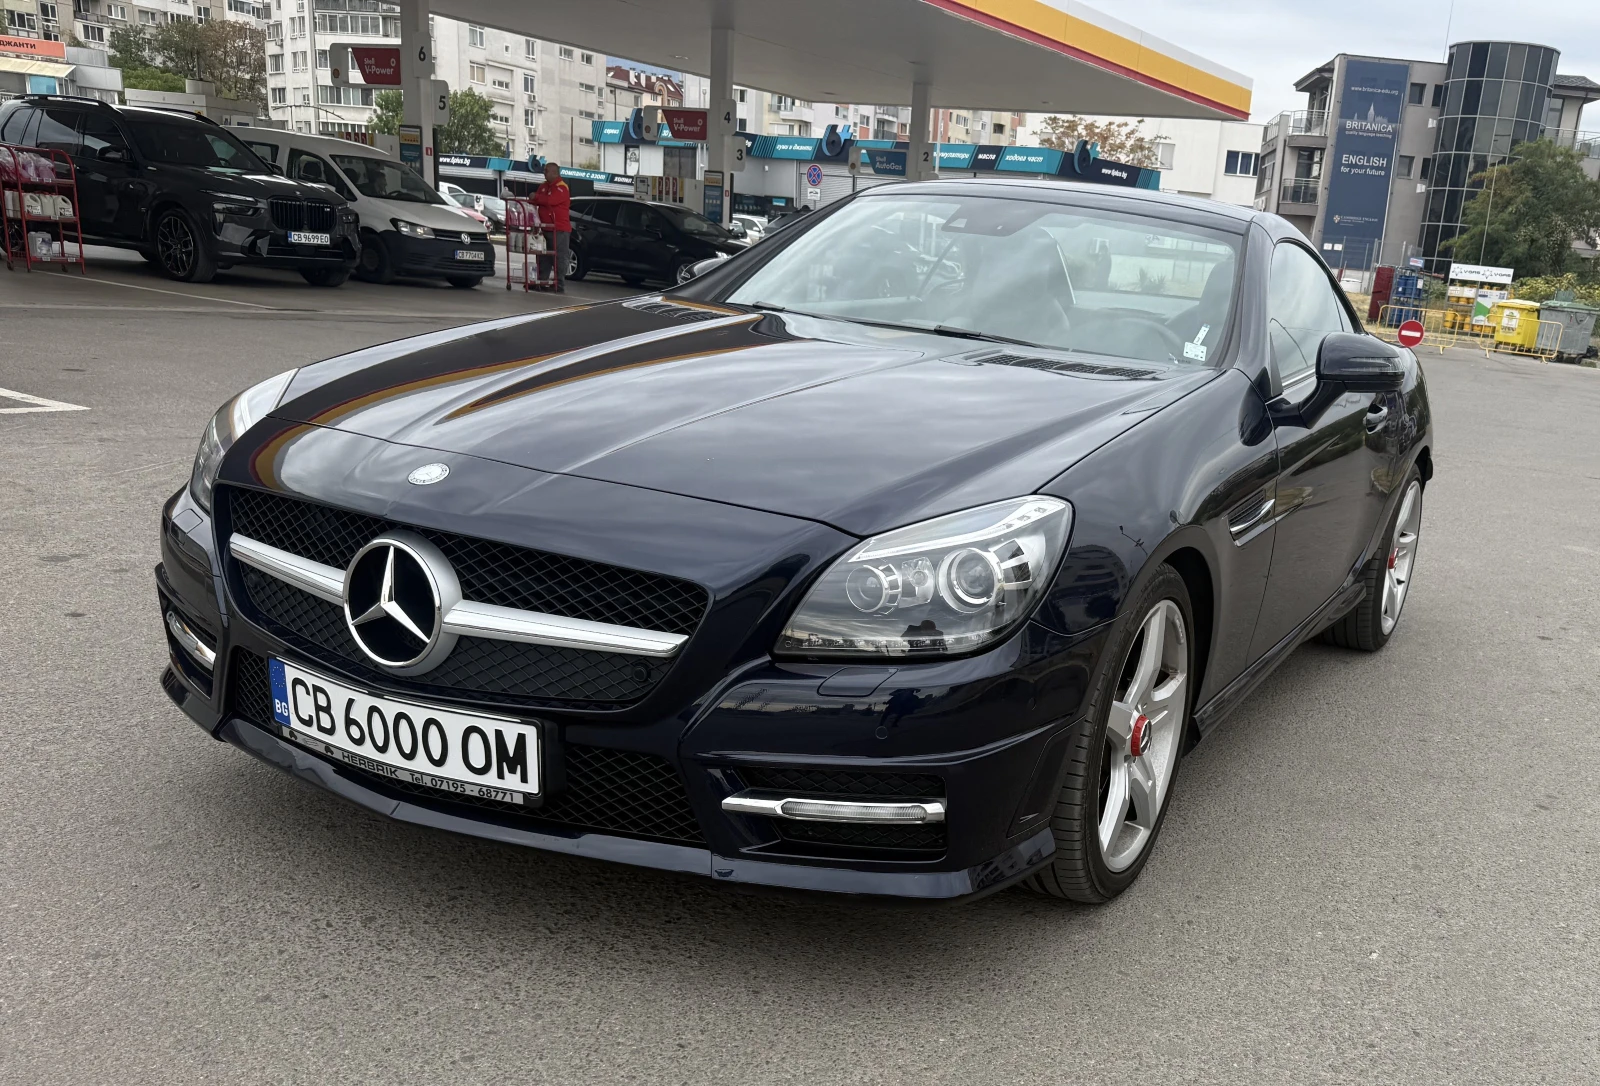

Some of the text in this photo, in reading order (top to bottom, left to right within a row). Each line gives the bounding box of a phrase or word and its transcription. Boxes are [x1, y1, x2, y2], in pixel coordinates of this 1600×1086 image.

[0, 40, 36, 49] ДЖАНТИ
[418, 46, 426, 62] 6
[364, 57, 375, 65] Shell
[365, 65, 394, 76] V-Power
[438, 95, 446, 110] 5
[724, 111, 731, 124] 4
[673, 124, 701, 132] V-Power
[1345, 120, 1393, 133] BRITANICA
[736, 148, 744, 161] 3
[922, 151, 930, 162] 2
[1341, 154, 1387, 167] ENGLISH
[875, 162, 903, 171] AutoGas
[1366, 168, 1386, 176] future
[293, 233, 302, 242] CB
[274, 699, 290, 717] BG
[292, 677, 529, 785] CB 6000 OM
[341, 752, 400, 780] HERBRIK
[409, 772, 428, 788] Tel.
[431, 780, 466, 794] 07195
[478, 788, 515, 803] 68771
